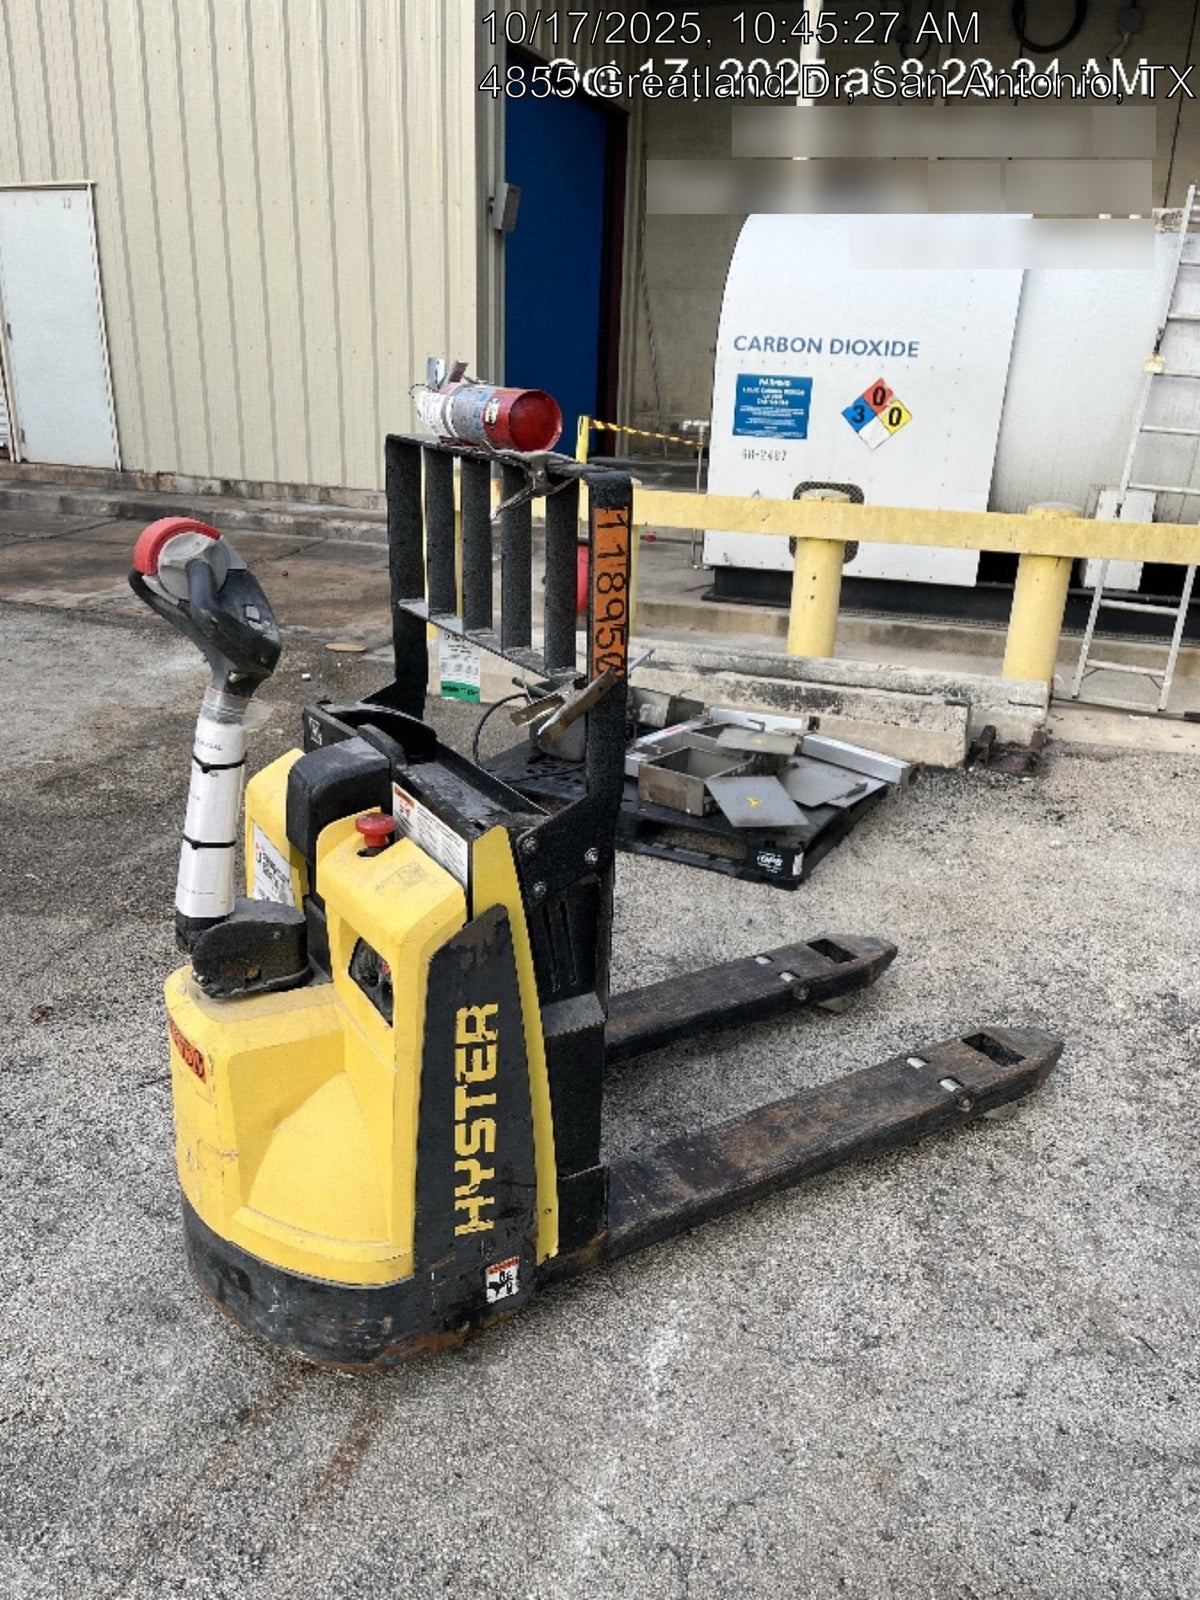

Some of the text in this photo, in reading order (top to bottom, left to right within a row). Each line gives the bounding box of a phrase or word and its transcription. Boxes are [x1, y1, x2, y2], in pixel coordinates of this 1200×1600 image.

[733, 335, 920, 358] CARBON DIOXIDE
[872, 386, 886, 406] 0
[851, 405, 865, 424] 3
[888, 406, 902, 427] 0
[454, 1002, 499, 1237] HYSTER
